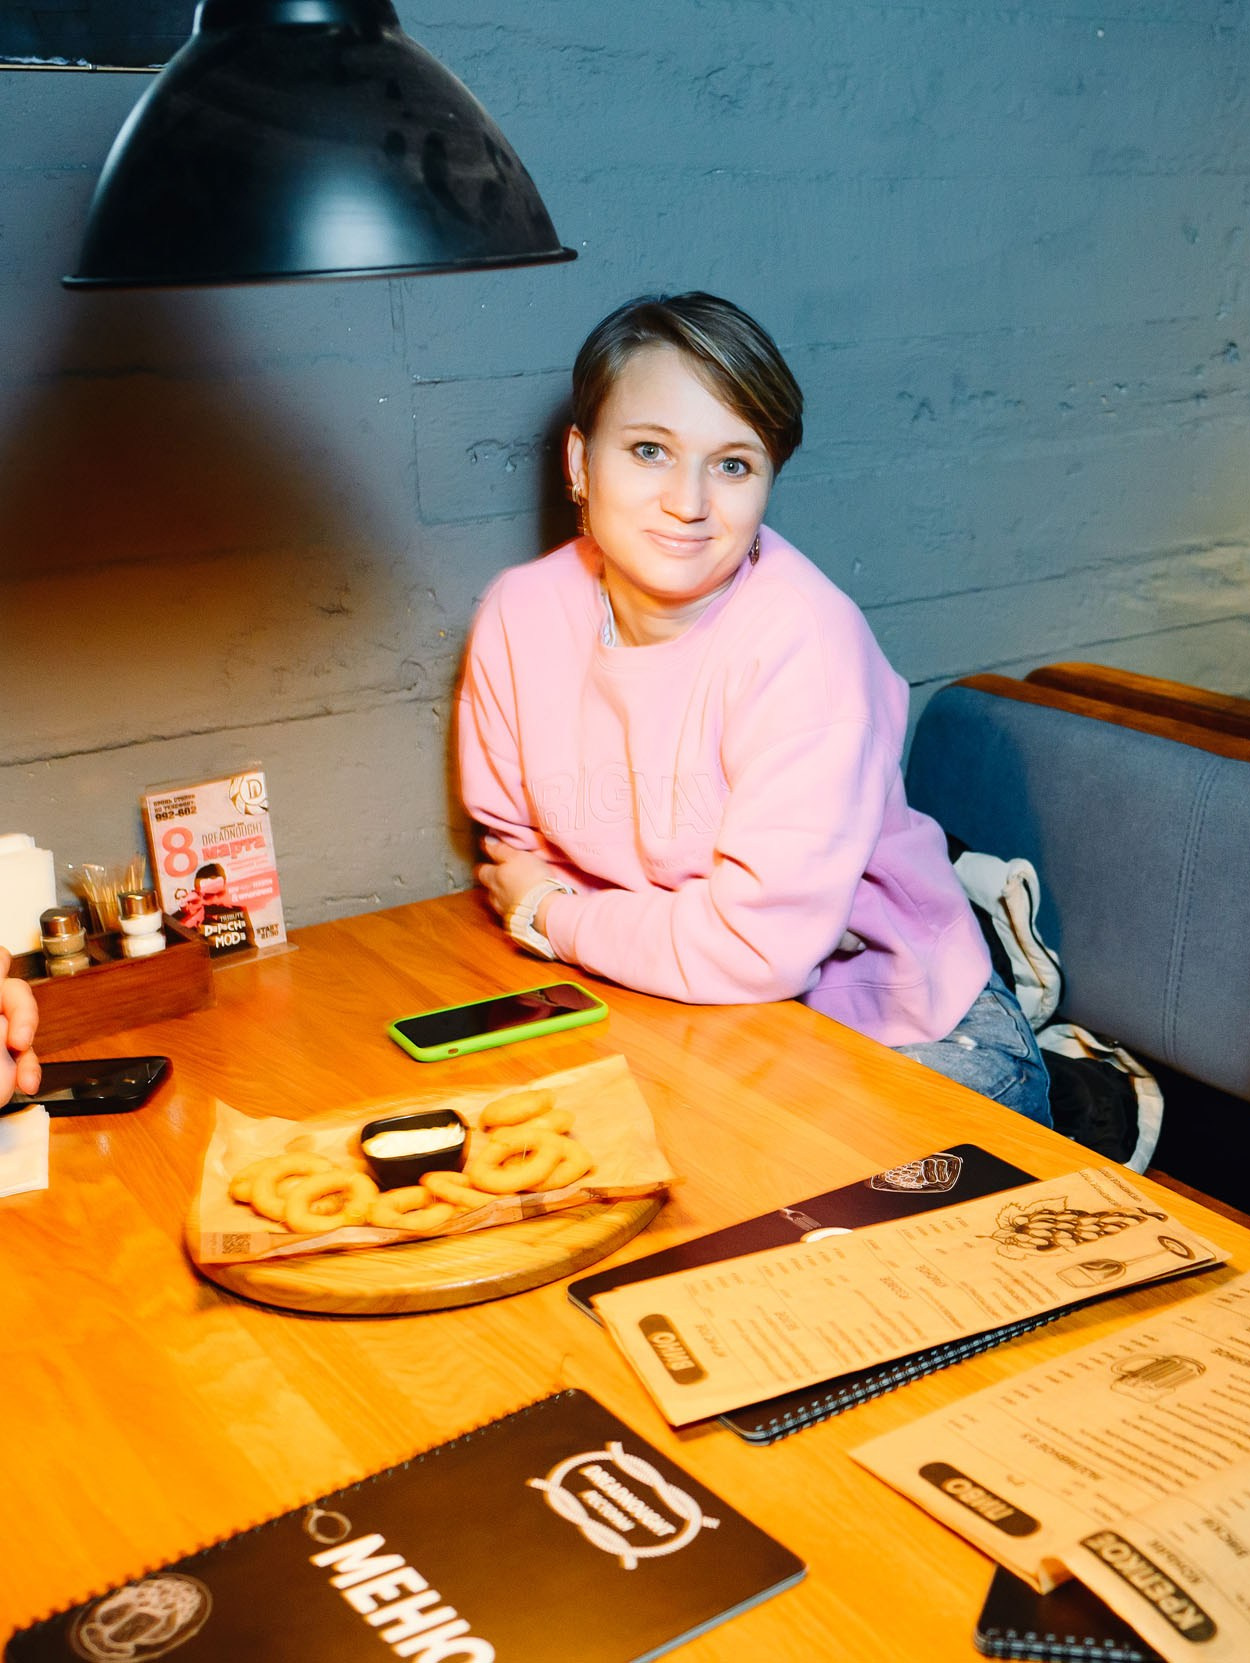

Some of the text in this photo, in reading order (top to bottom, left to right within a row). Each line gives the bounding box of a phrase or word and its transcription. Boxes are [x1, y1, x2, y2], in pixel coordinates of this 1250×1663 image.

[162, 827, 199, 878] 8
[201, 821, 263, 846] DREADNOUGHT
[649, 1330, 695, 1372] ВИНО
[941, 1476, 1018, 1523] ПИВО
[1084, 1532, 1205, 1631] КРЕПКОЕ
